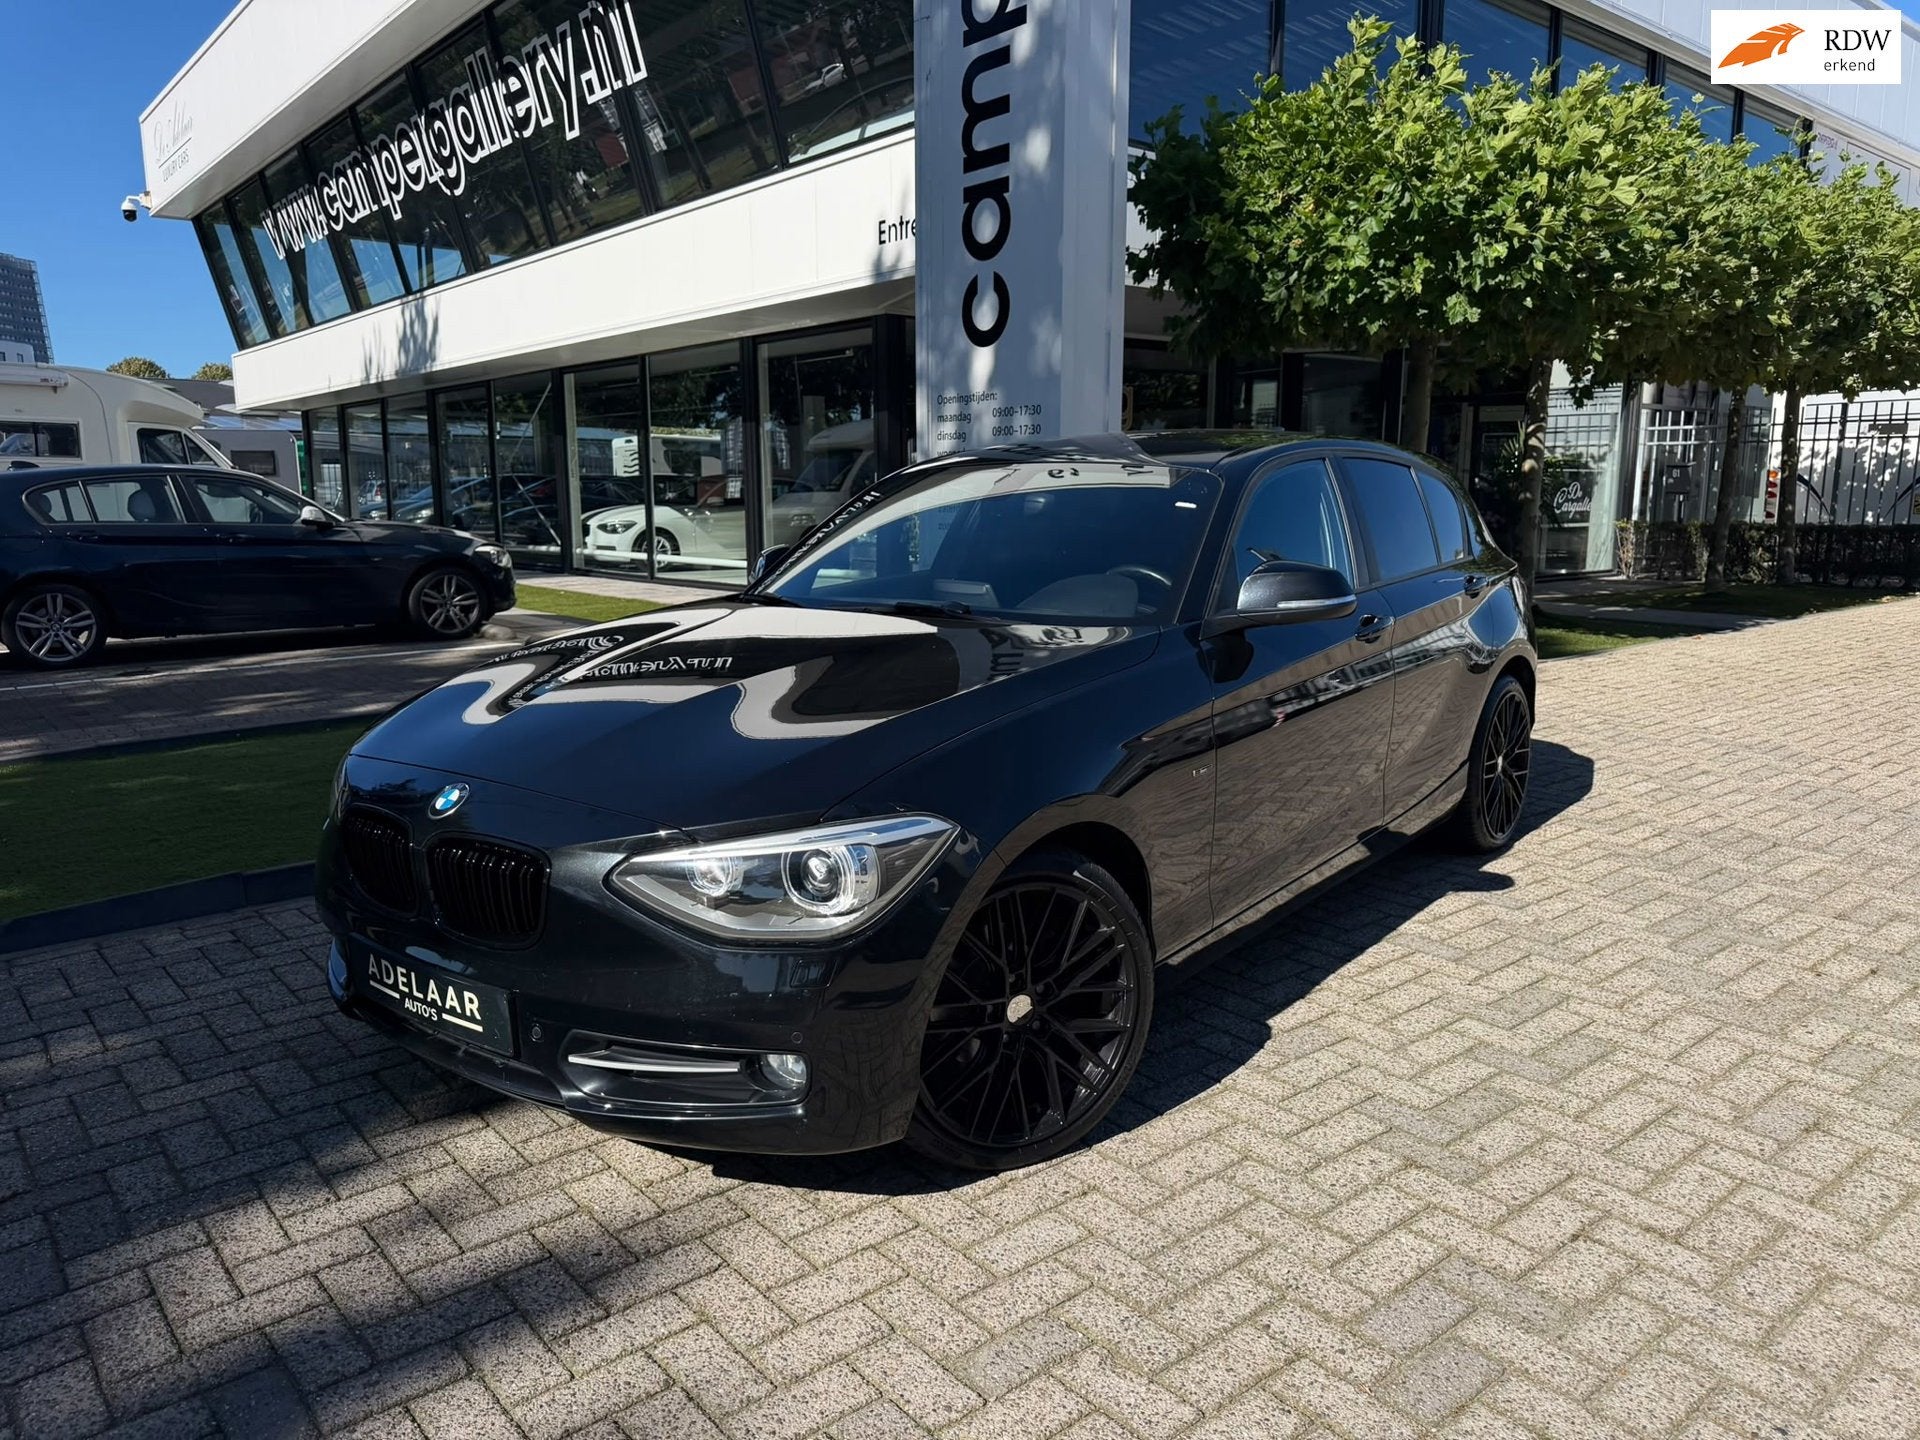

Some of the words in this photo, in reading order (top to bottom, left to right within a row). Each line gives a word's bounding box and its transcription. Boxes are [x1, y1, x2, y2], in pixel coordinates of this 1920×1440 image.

[936, 390, 998, 406] Openingstijden:
[936, 411, 972, 424] maandag
[936, 430, 967, 443] dinsdag
[368, 953, 482, 1020] ADELAAR
[404, 997, 438, 1021] AUTO'S
